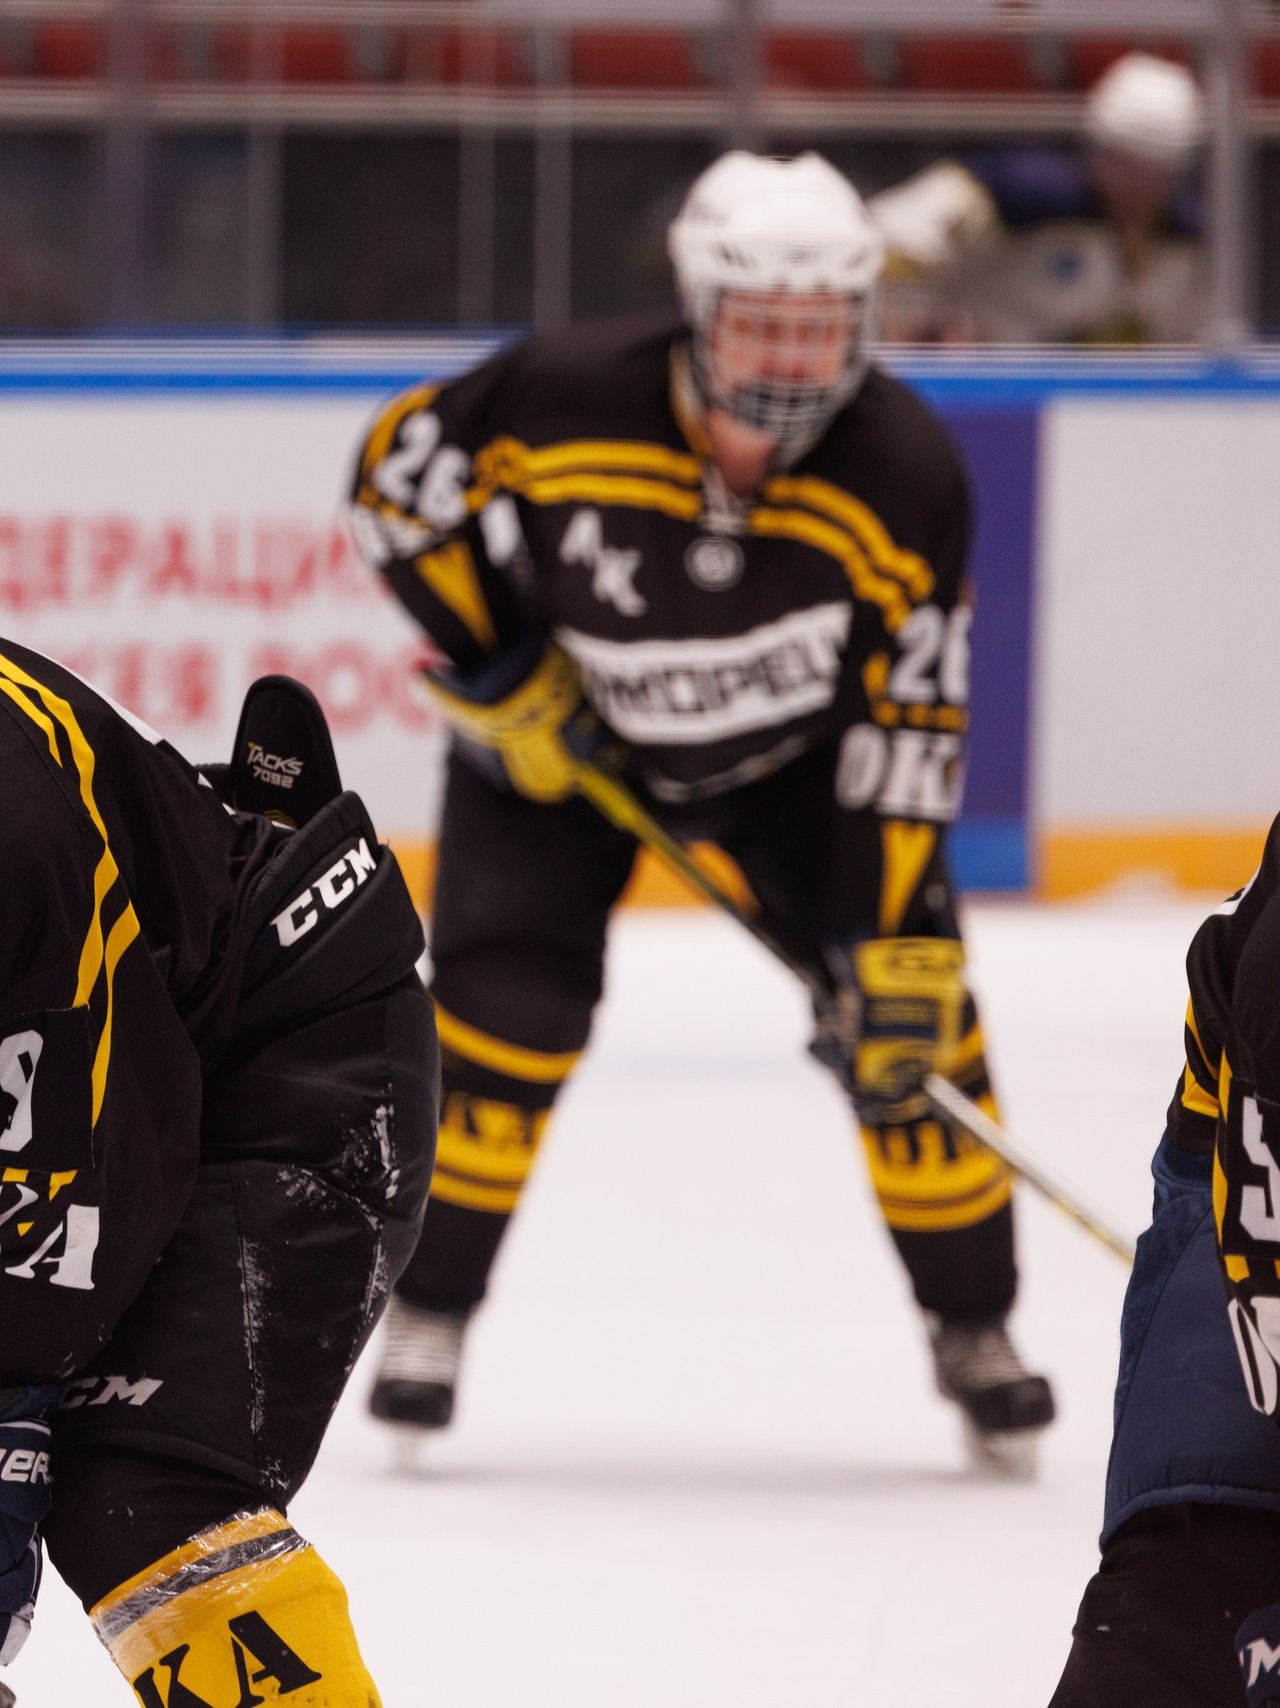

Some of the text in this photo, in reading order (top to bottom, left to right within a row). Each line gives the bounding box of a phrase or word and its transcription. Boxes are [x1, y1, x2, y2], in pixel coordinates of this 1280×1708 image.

[374, 411, 470, 527] 26
[246, 741, 304, 777] TACKS
[835, 722, 966, 822] ОК
[270, 837, 377, 947] CCM
[61, 1375, 164, 1410] CM
